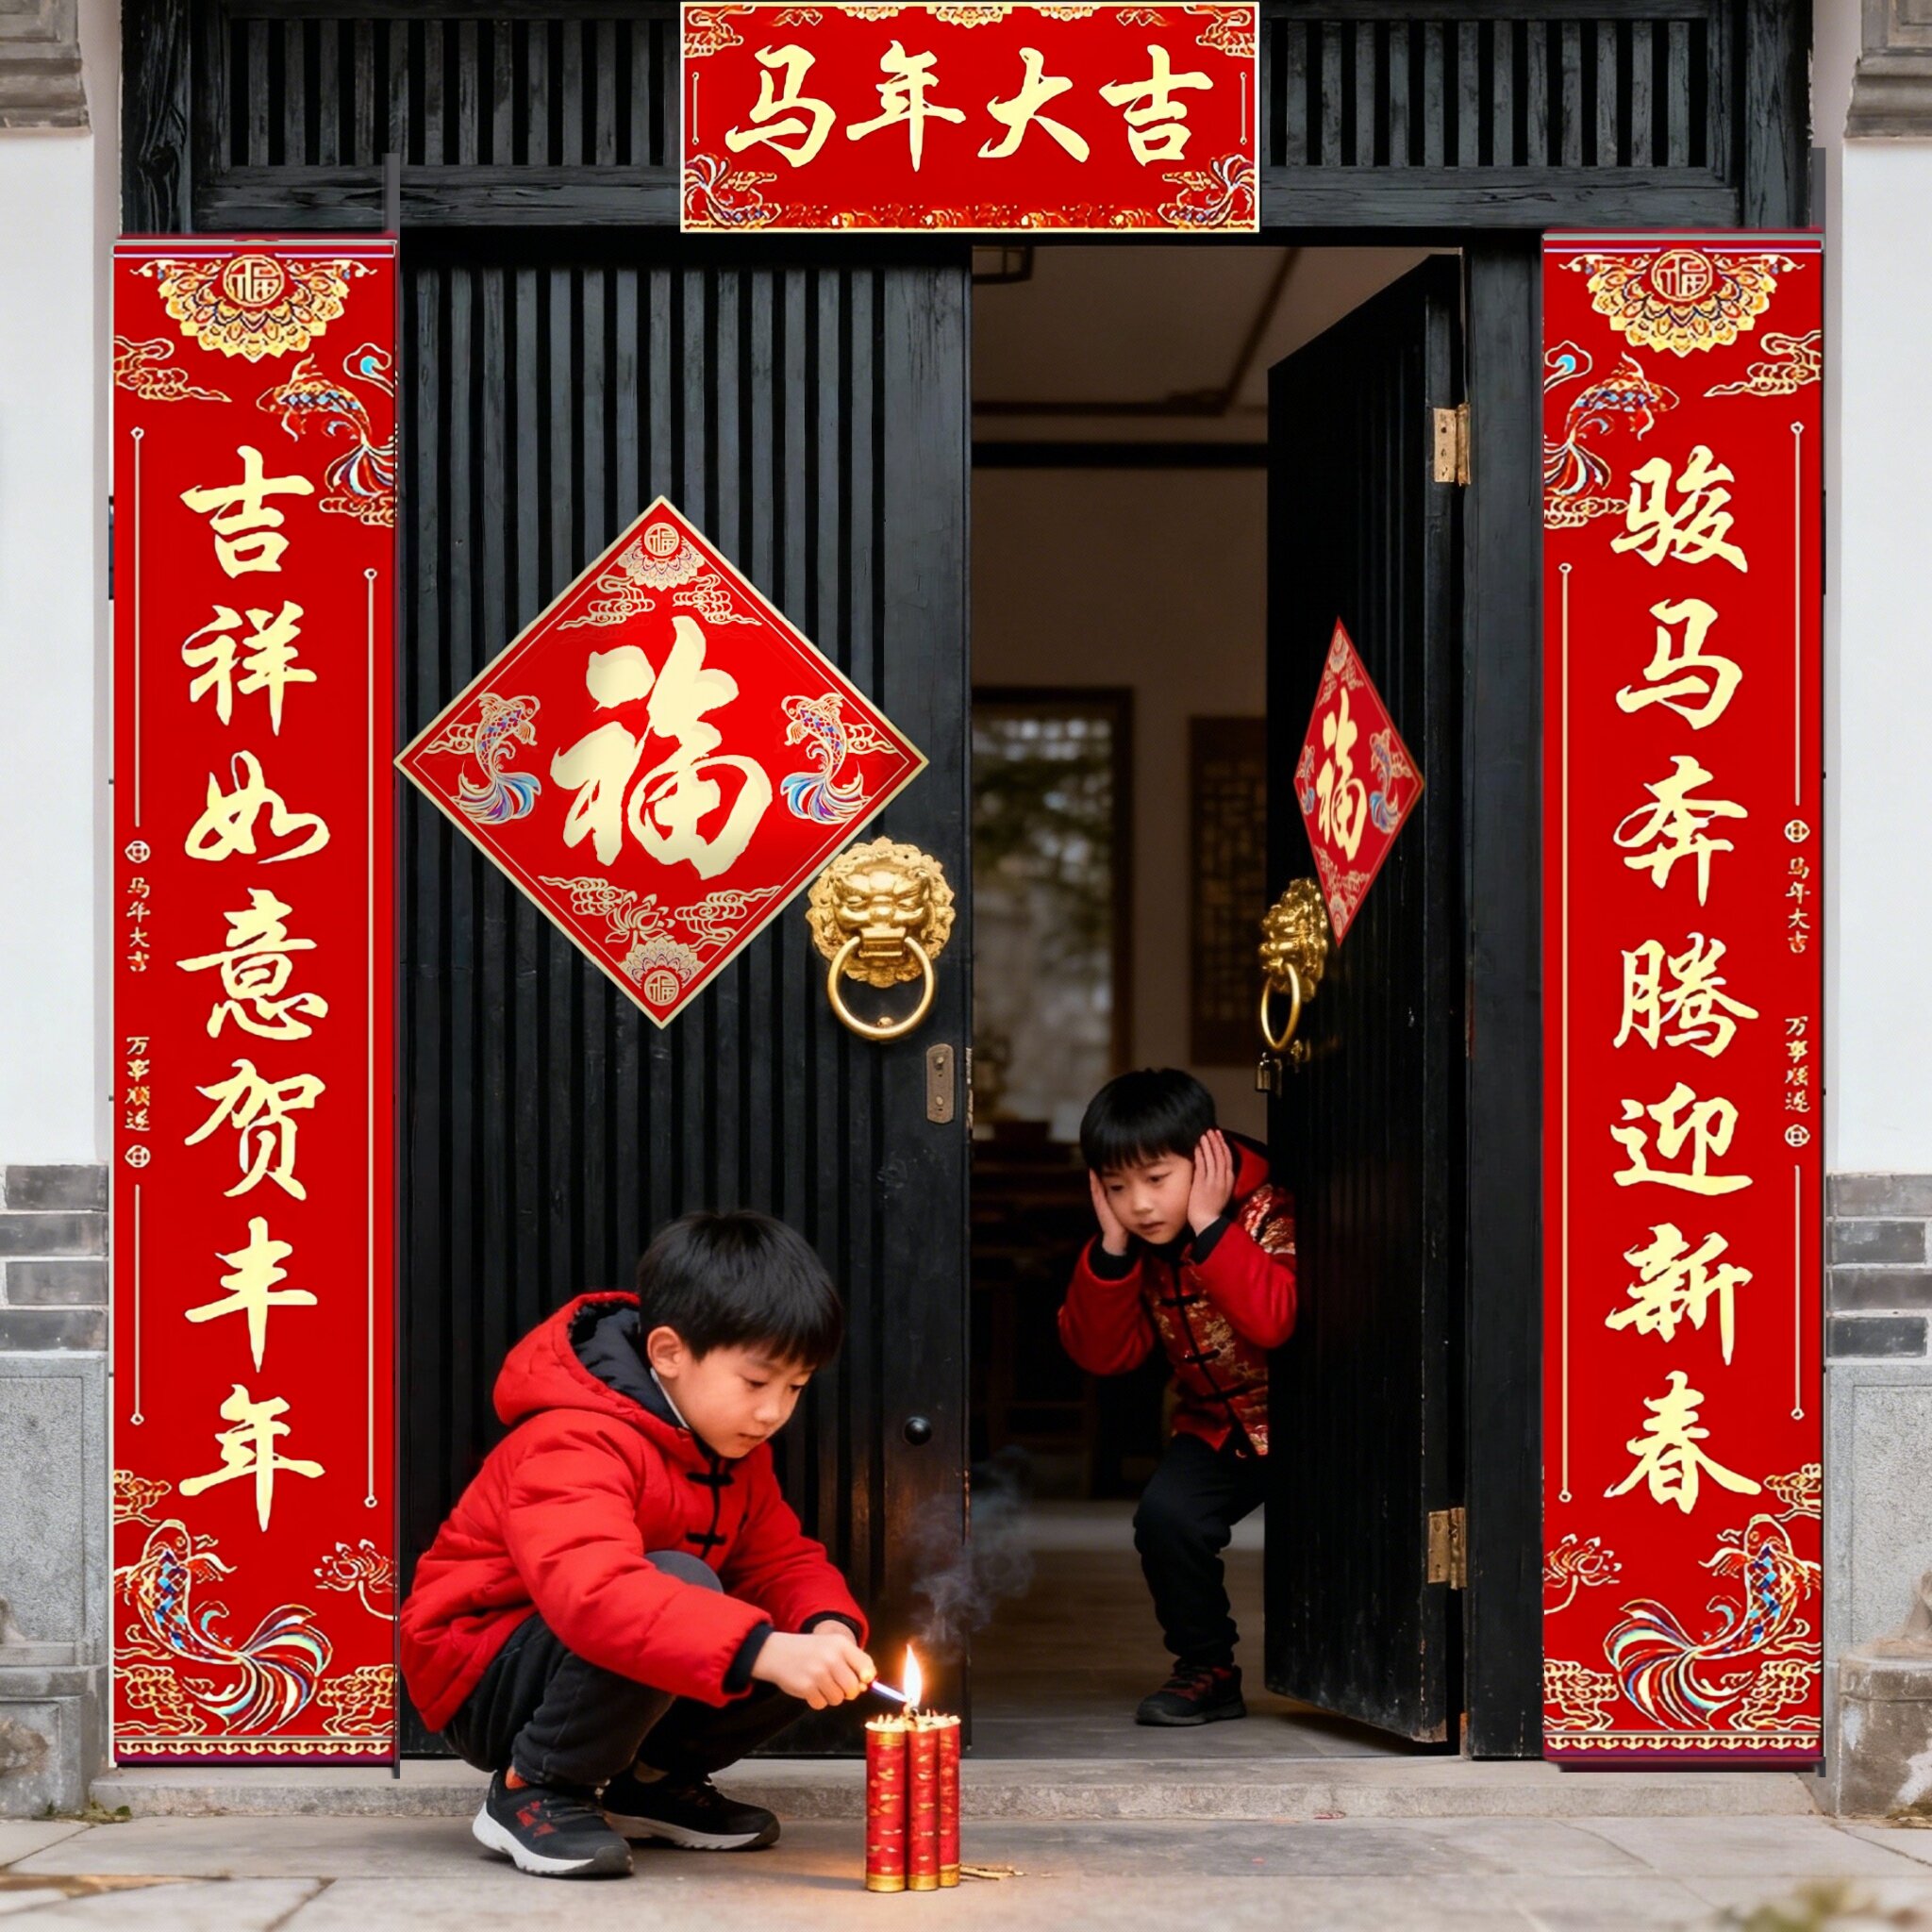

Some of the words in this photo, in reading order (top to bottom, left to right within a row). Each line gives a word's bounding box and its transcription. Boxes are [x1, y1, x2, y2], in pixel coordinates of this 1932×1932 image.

[725, 40, 1214, 172] 马年大吉
[550, 615, 773, 880] 福
[1315, 686, 1368, 862] 福
[176, 445, 330, 1532] 吉祥如意贺丰年
[1604, 444, 1762, 1514] 骏马奔腾迎新春
